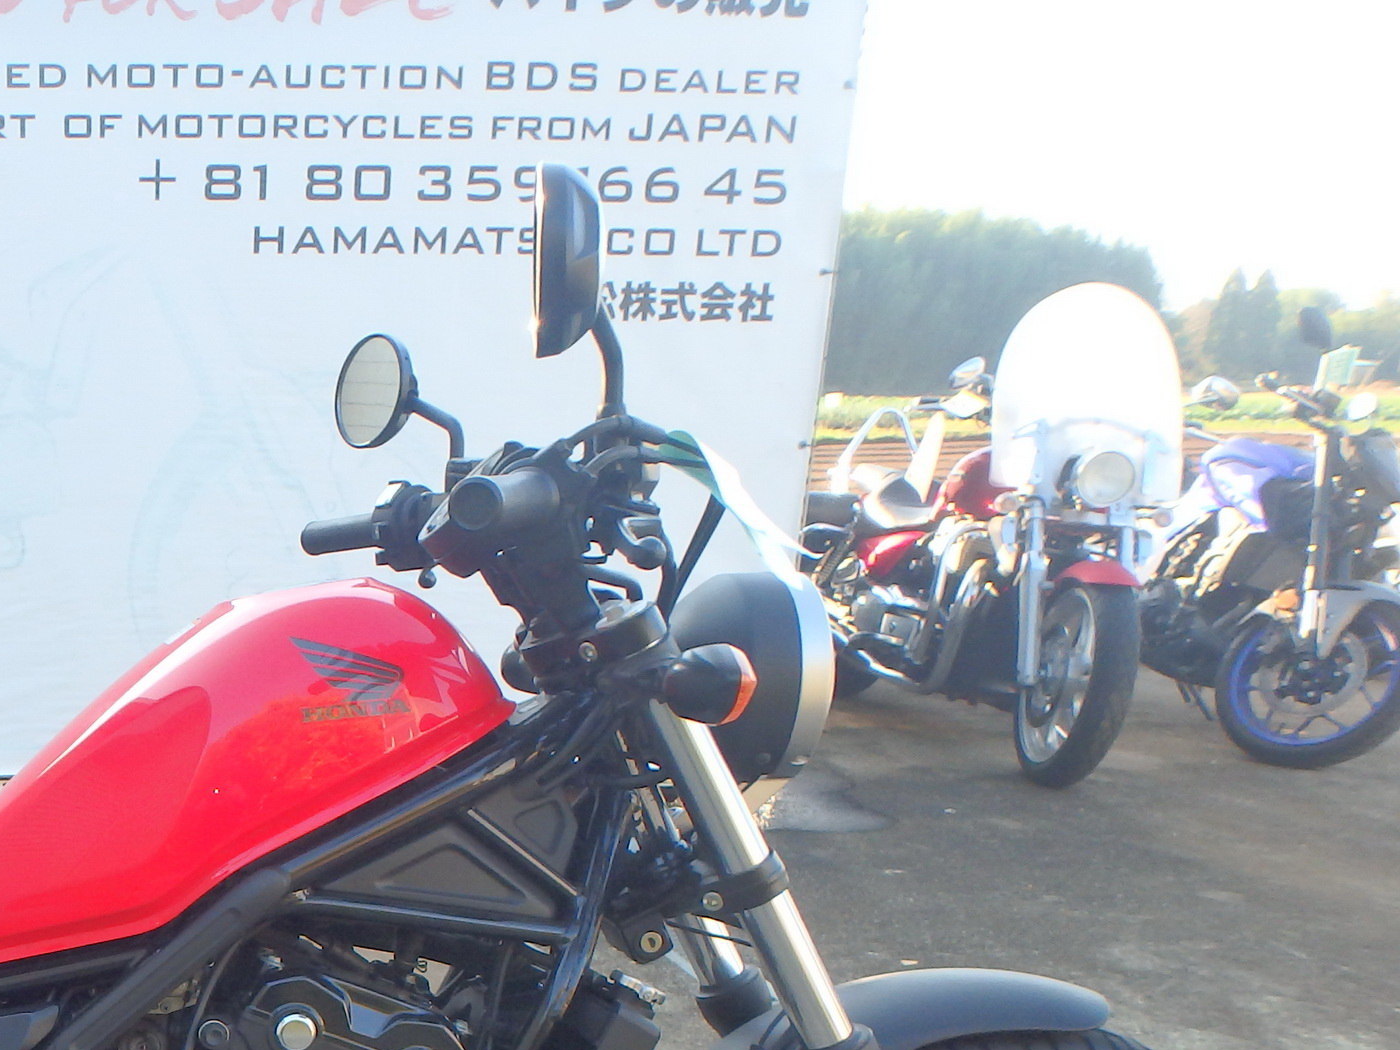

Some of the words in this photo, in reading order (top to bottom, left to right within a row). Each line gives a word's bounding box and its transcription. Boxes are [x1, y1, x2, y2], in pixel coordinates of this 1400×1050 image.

[86, 63, 464, 91] MOTO-AUCTION
[485, 61, 599, 92] BDS
[618, 67, 800, 95] DEALER
[63, 114, 123, 139] OF
[137, 114, 474, 140] MOTORCYCLES
[490, 115, 612, 141] FROM
[628, 113, 798, 144] JAPAN
[203, 163, 268, 201] 81
[305, 163, 392, 202] 80
[416, 163, 681, 204] 35966
[703, 168, 788, 206] 45
[252, 224, 535, 256] HAMAMATS
[606, 227, 676, 256] CO
[695, 228, 783, 258] LTD
[302, 700, 411, 723] HONDA
